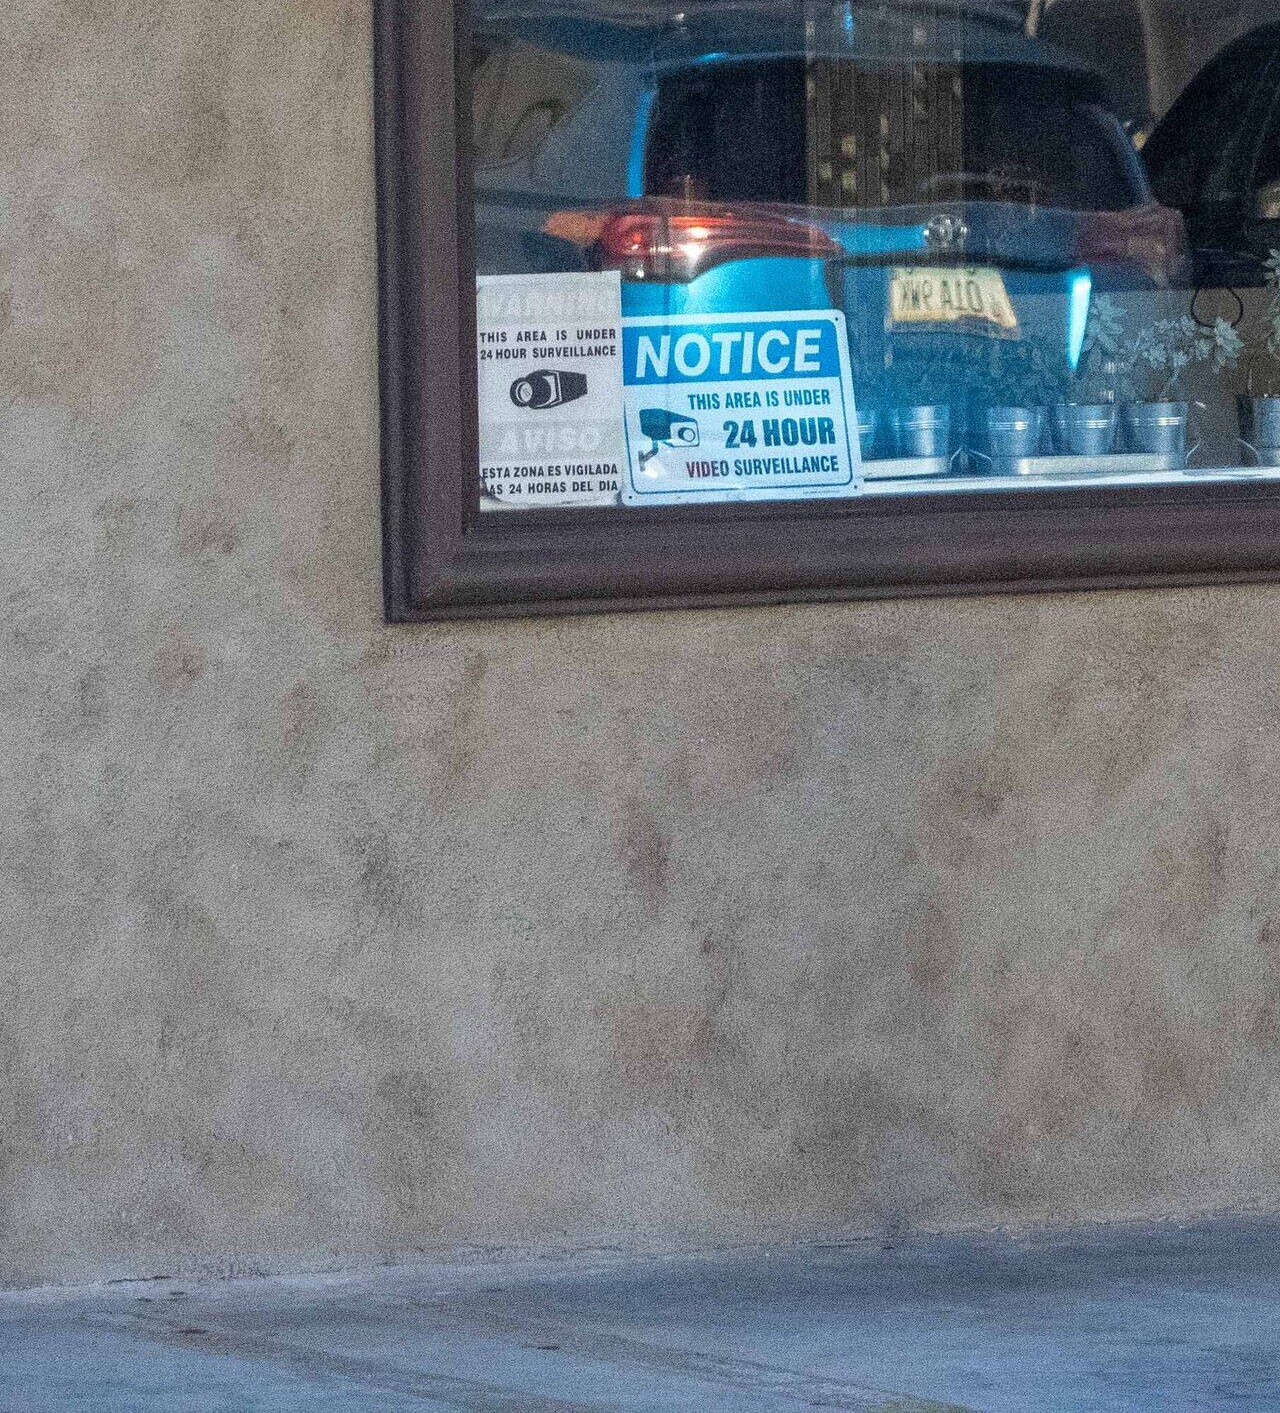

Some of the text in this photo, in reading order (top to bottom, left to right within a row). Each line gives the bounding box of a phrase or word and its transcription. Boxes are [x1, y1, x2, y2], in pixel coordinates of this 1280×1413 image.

[480, 328, 616, 343] THIS AREA IS UNDER
[480, 345, 617, 360] 24 HOUR SURVEILLANCE
[635, 328, 822, 378] NOTICE
[687, 388, 831, 410] THIS AREA IS UNDER
[722, 416, 836, 449] 24 HOUR
[482, 463, 618, 479] ESTA ZONA ES VIGILADA
[686, 455, 840, 478] VIDEO SURVEILLANCE
[509, 484, 522, 494] 24
[528, 482, 567, 494] HORAS
[572, 480, 594, 492] DEL
[599, 480, 618, 492] DIA
